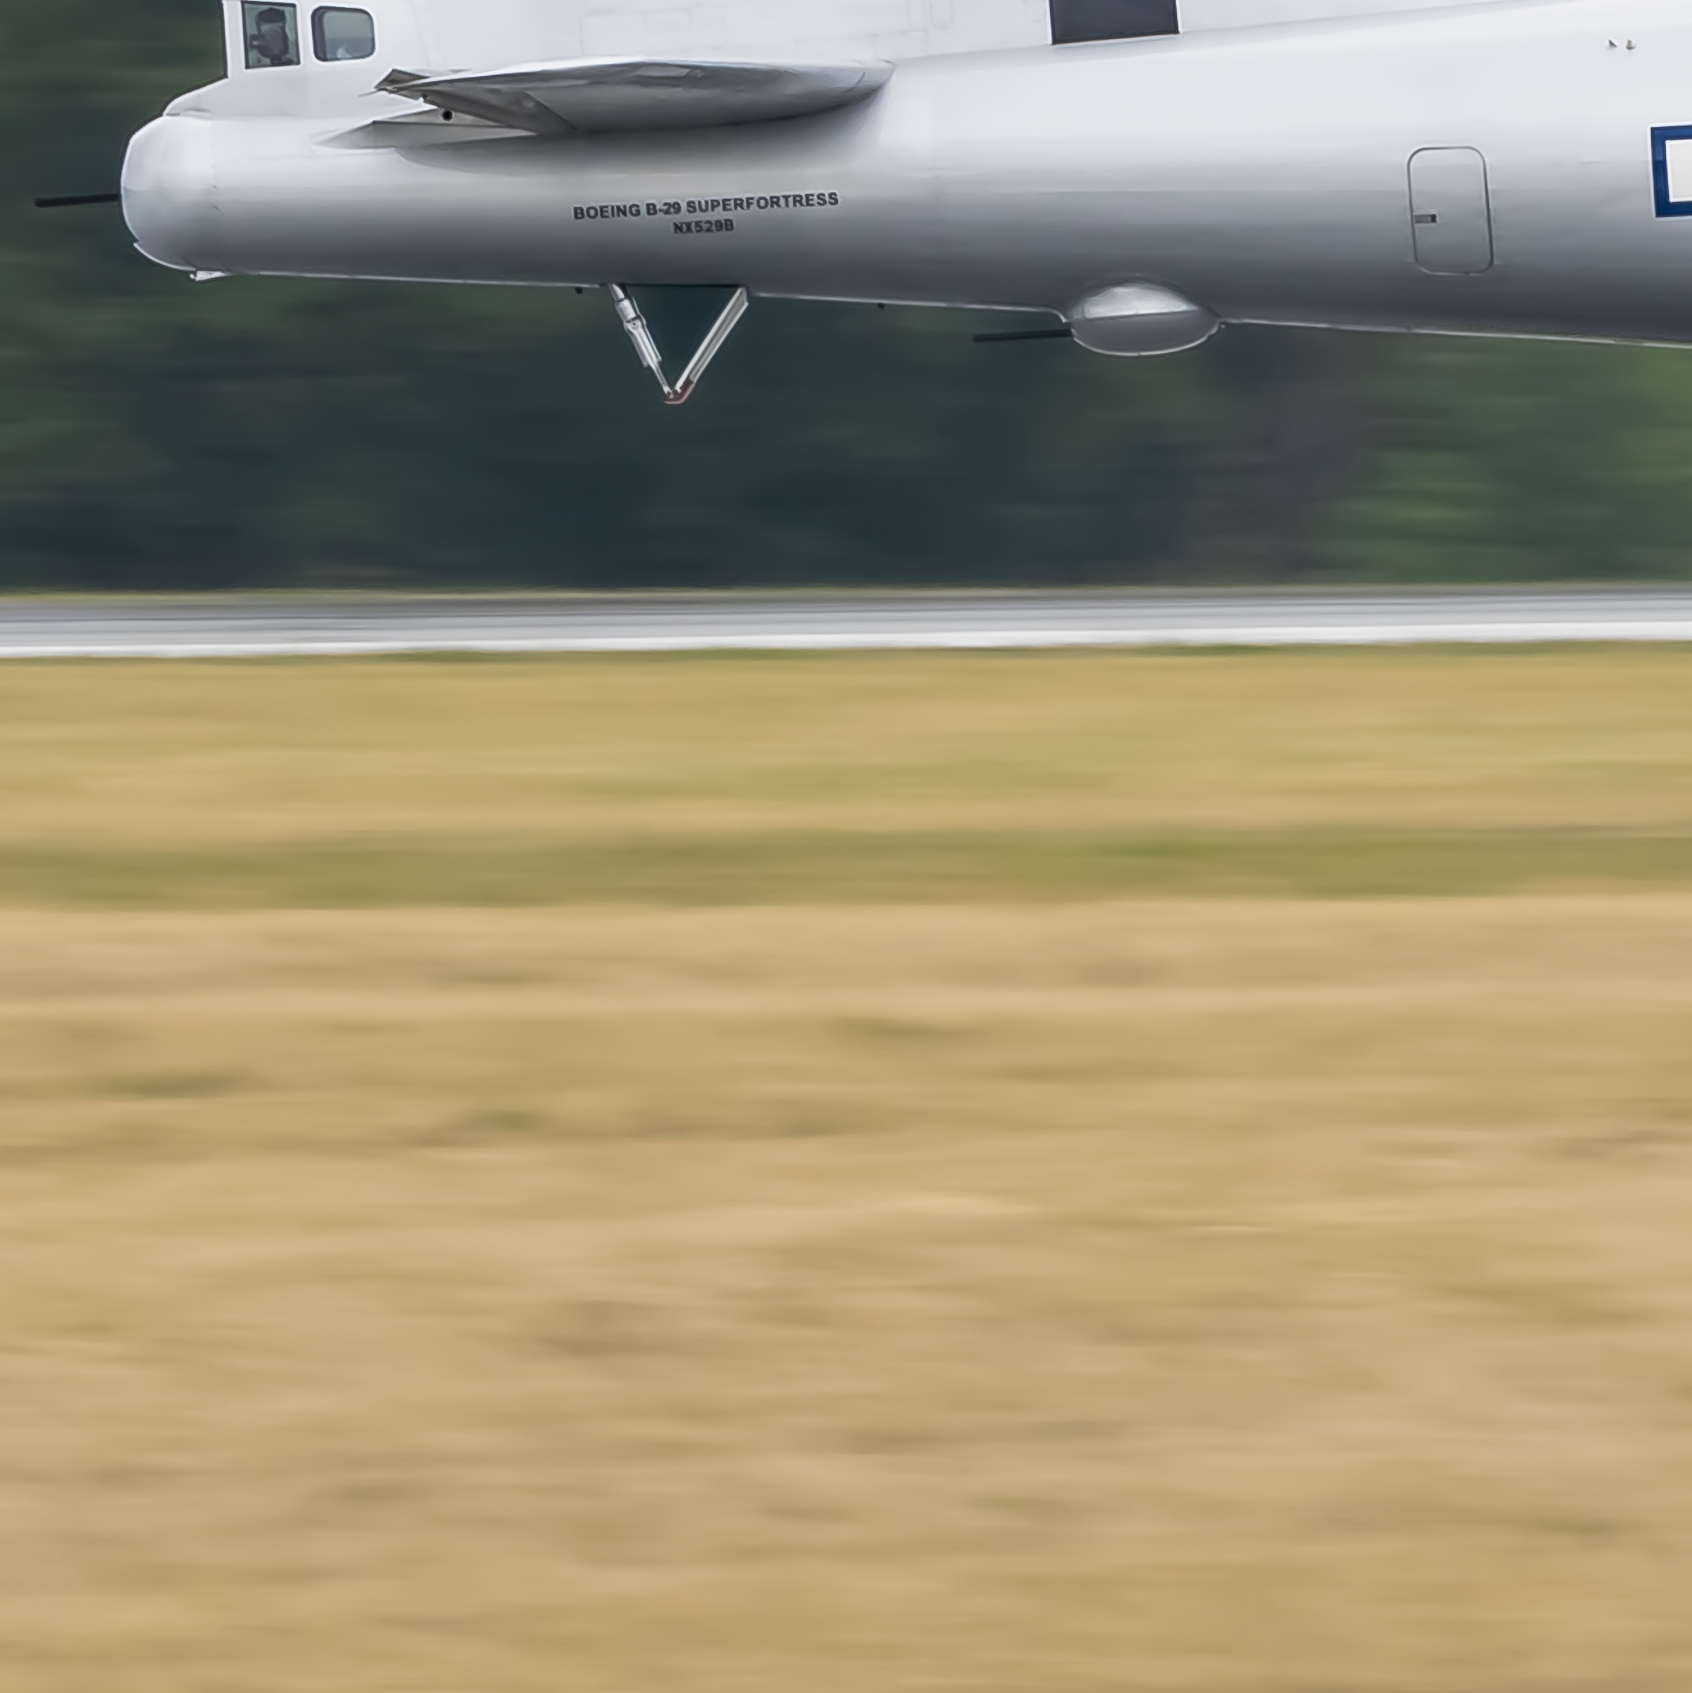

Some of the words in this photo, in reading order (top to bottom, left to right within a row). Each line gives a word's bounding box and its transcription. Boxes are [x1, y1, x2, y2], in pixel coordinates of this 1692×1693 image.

[573, 202, 642, 221] BOEING
[645, 201, 682, 217] B-29
[686, 191, 840, 215] SUPERFORTRESS
